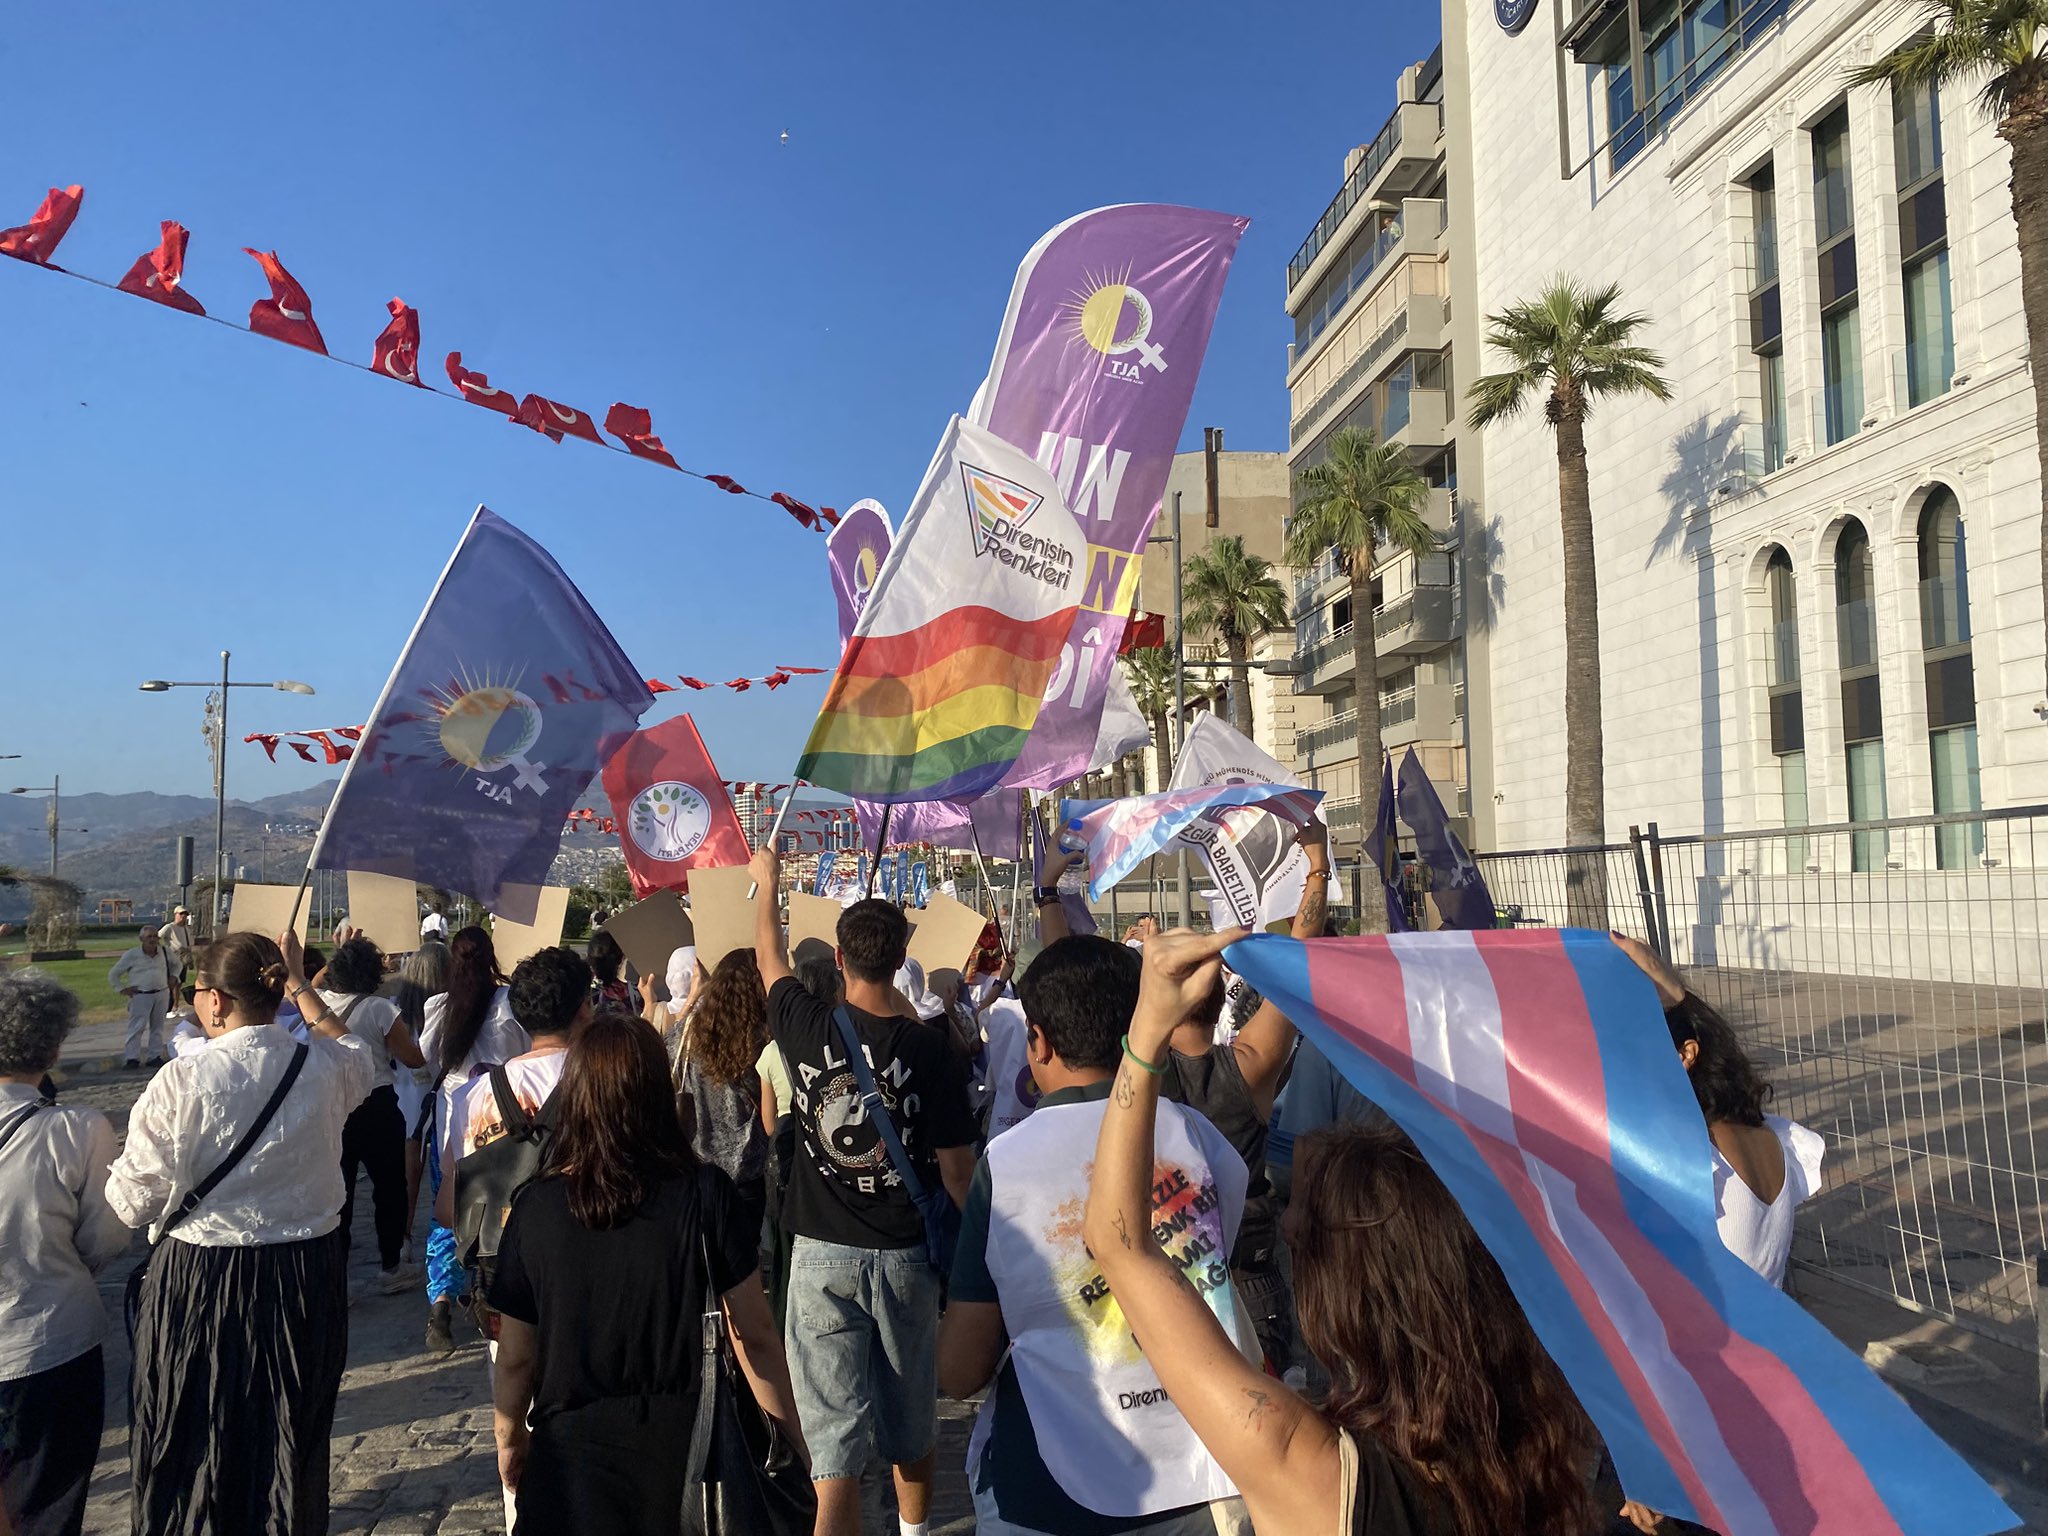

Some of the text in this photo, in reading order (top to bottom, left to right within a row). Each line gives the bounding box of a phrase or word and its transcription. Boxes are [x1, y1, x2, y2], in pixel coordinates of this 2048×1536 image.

[1111, 360, 1140, 380] TJA
[984, 536, 1071, 590] Renkleri
[476, 777, 512, 805] TJA
[1180, 824, 1219, 850] ZGÜR
[1152, 1205, 1197, 1247] ENK
[1118, 1387, 1168, 1410] Direni
